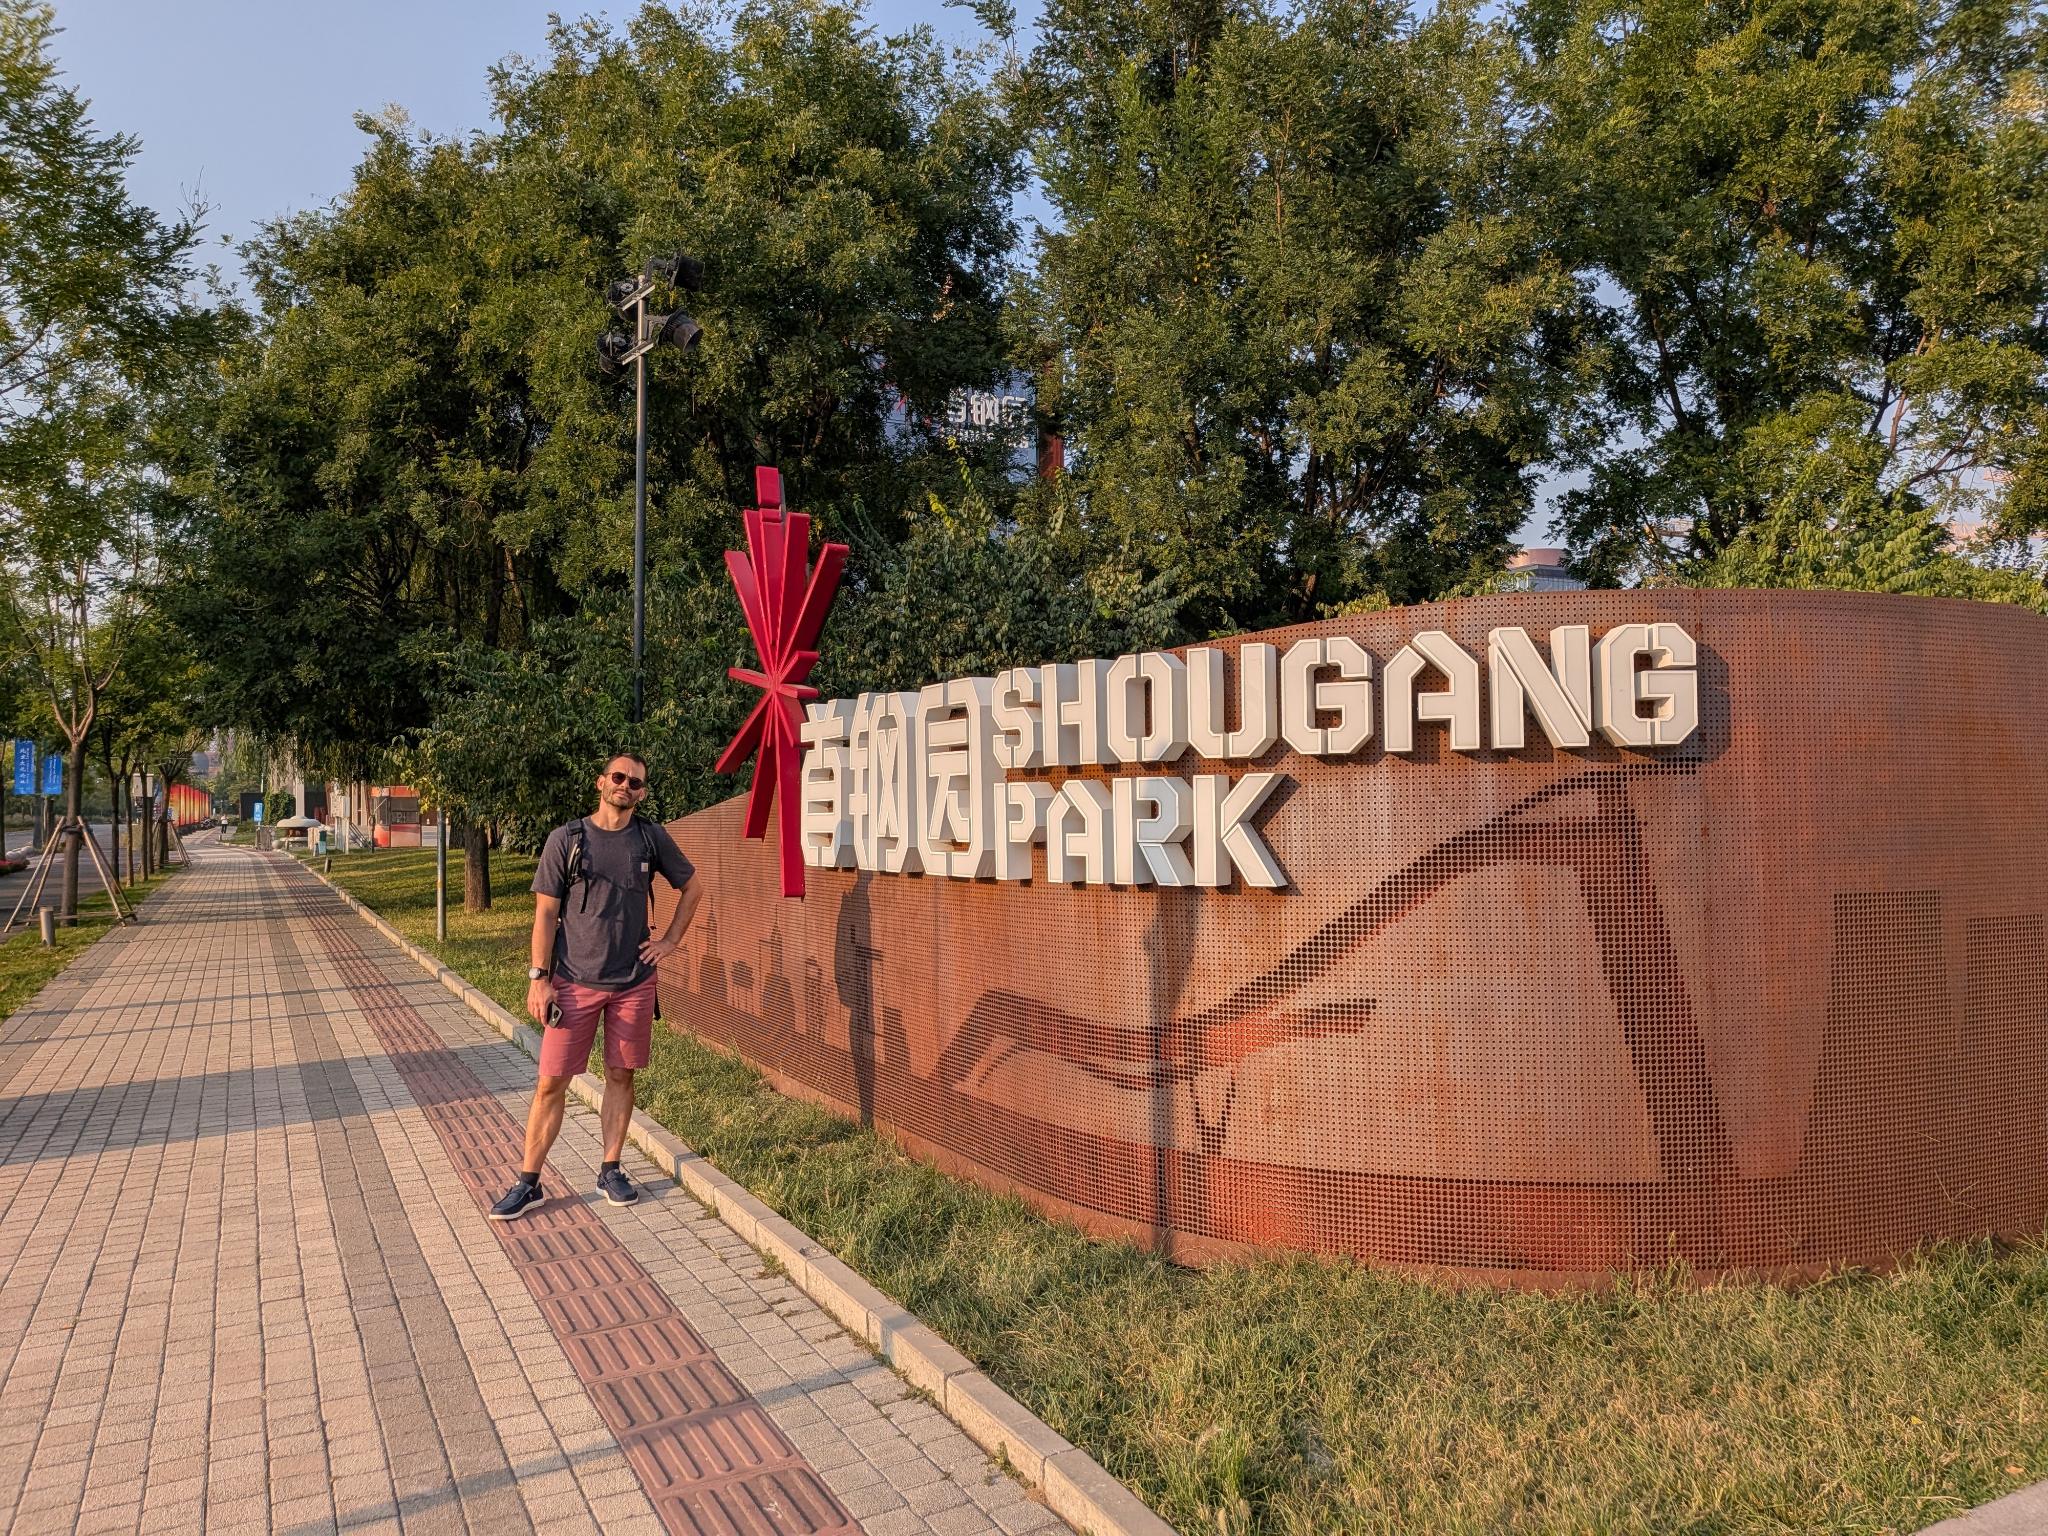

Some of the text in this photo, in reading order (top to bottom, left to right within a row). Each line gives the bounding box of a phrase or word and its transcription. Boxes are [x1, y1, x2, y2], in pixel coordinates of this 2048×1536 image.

[992, 621, 1699, 767] SHOUGANG
[800, 676, 985, 879] 首钢园
[993, 773, 1288, 888] PARK
